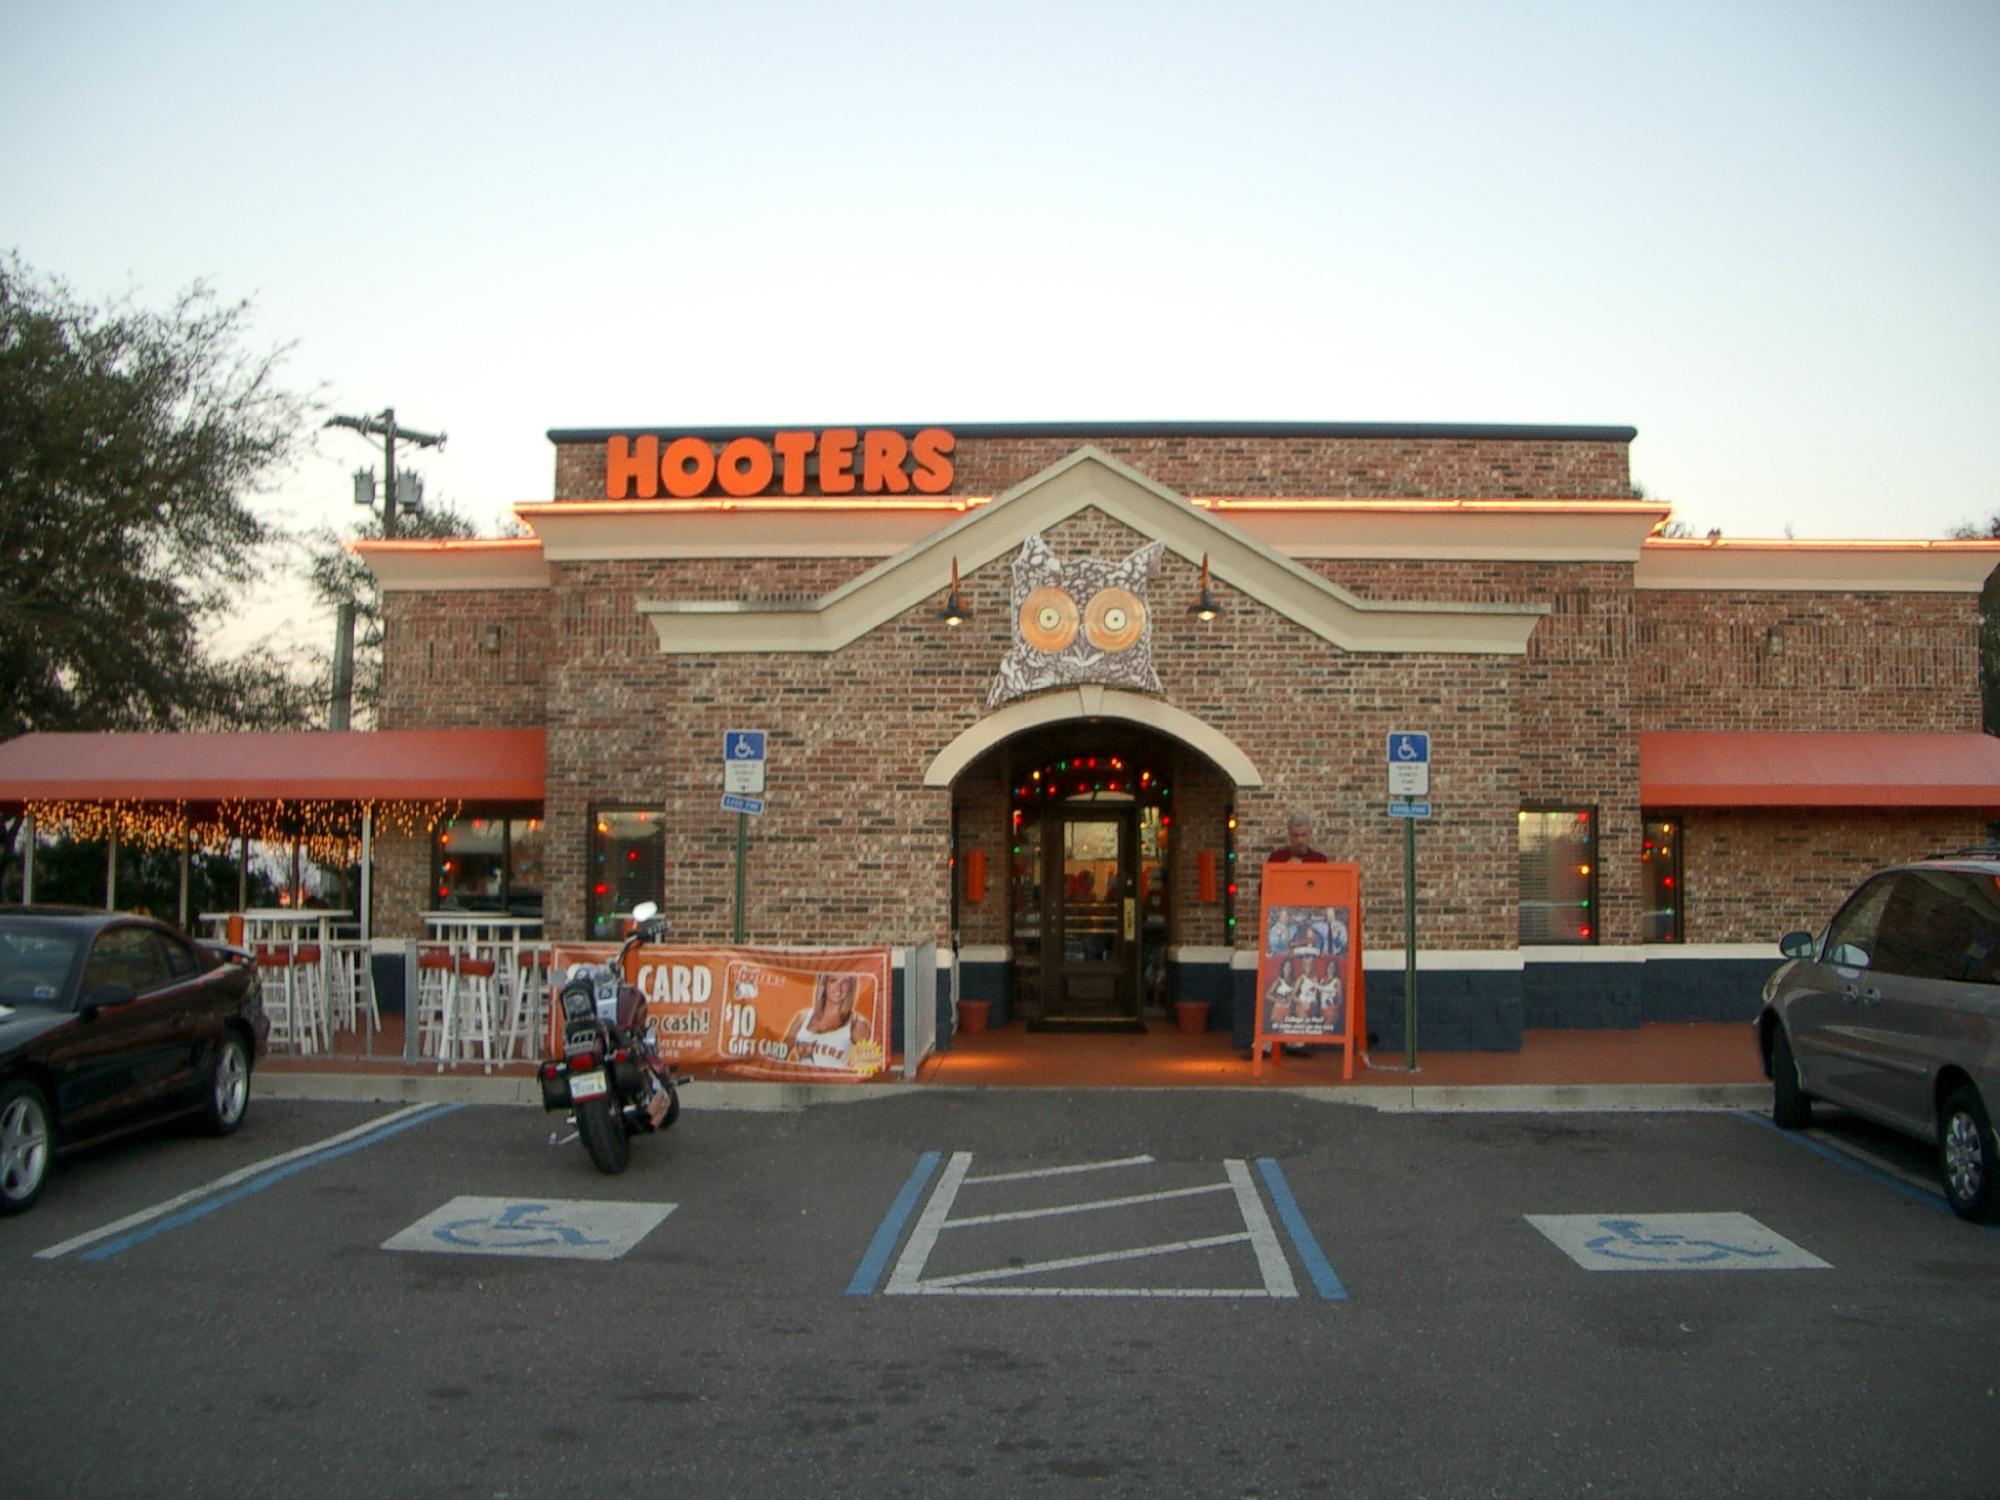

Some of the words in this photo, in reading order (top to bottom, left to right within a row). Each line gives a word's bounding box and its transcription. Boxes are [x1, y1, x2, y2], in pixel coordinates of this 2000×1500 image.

[606, 428, 957, 500] HOOTERS
[637, 964, 712, 1004] CARD
[661, 1007, 710, 1035] cash!
[728, 1037, 757, 1056] GIFT
[758, 1038, 788, 1059] CARD
